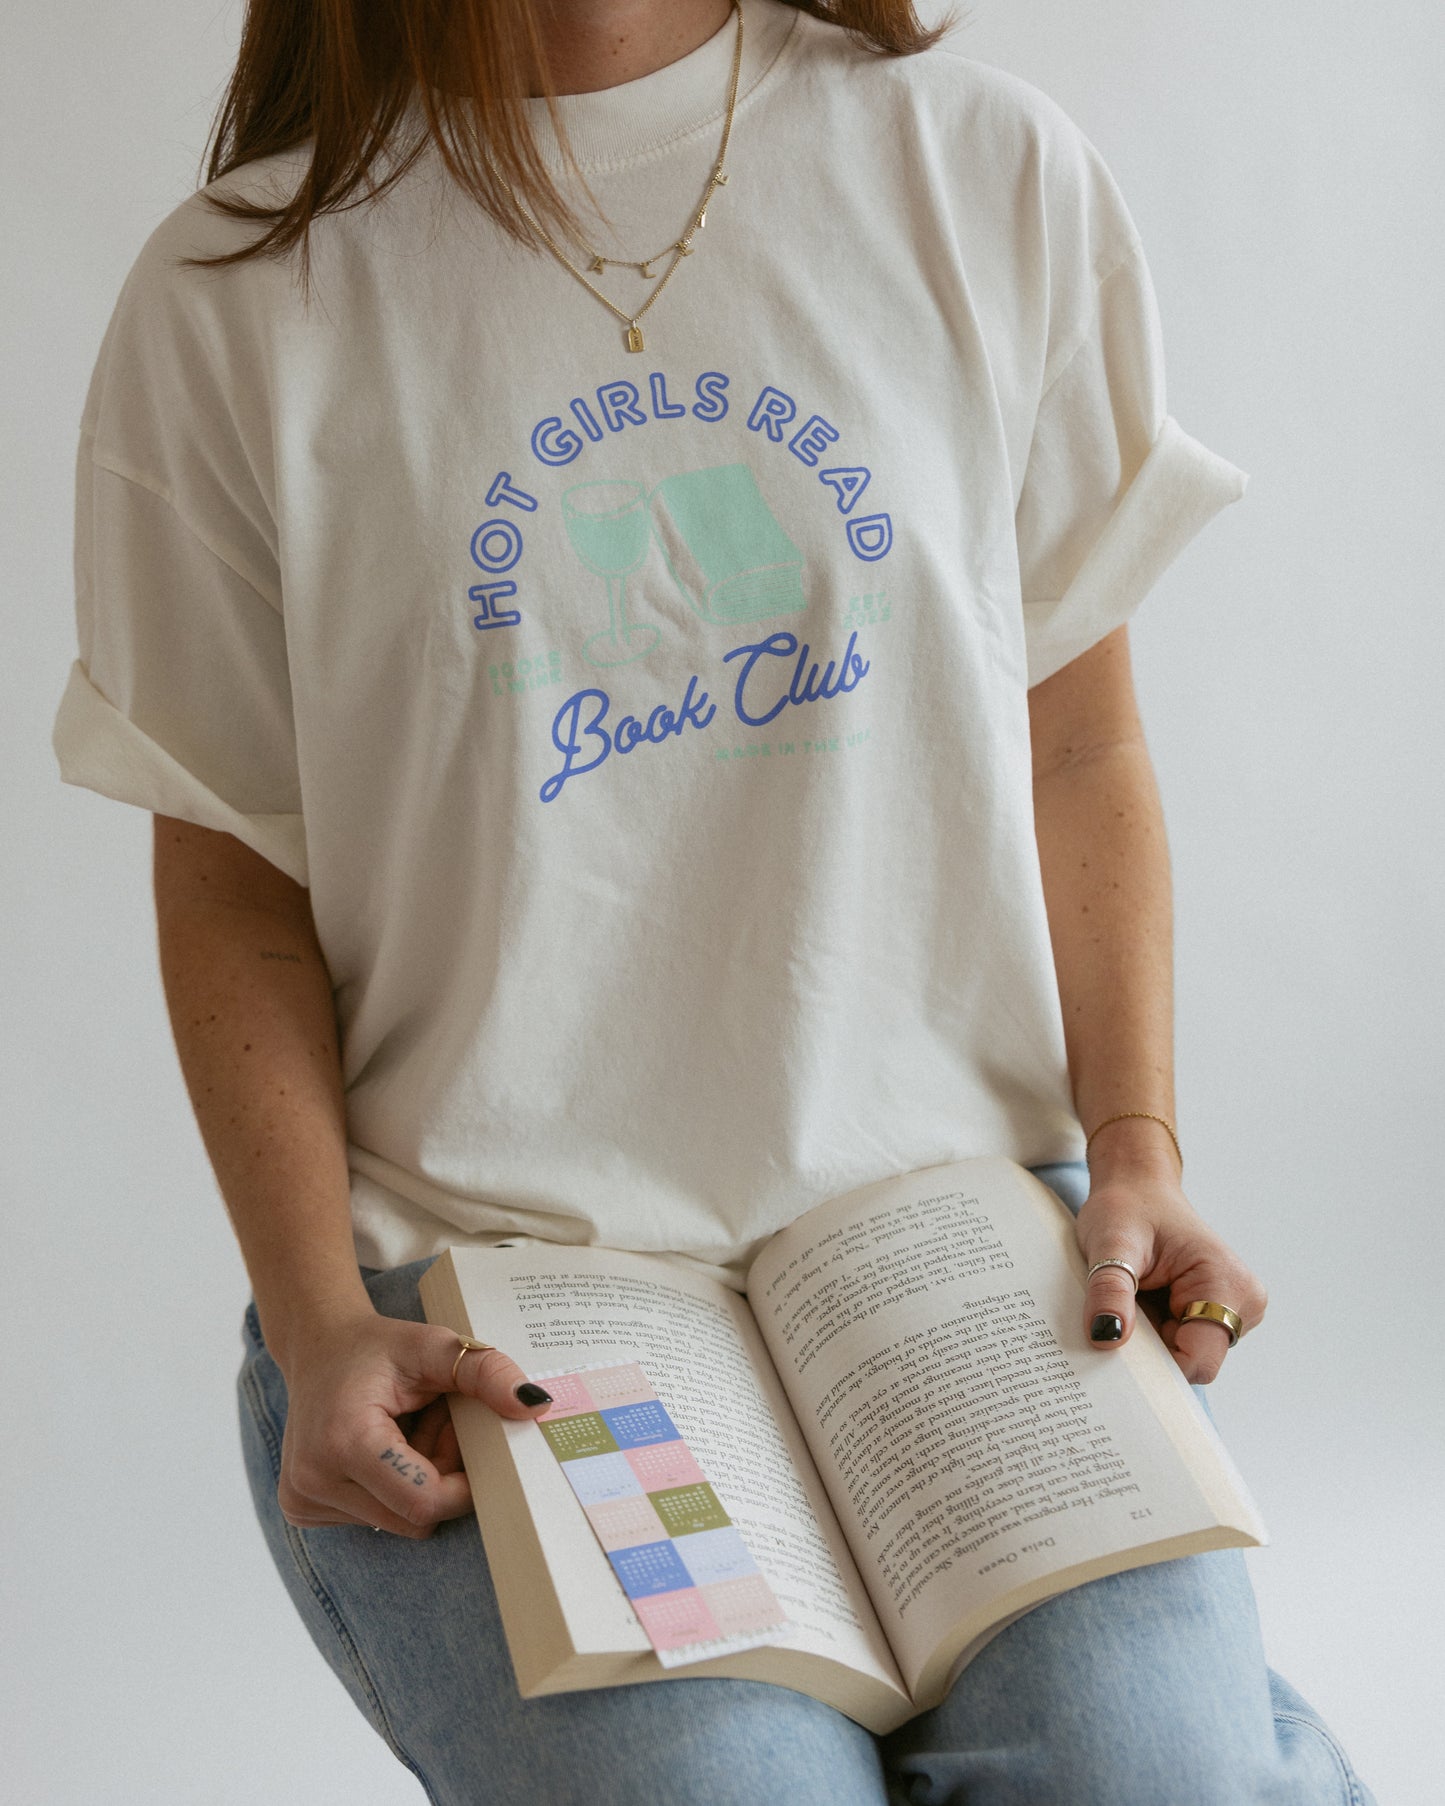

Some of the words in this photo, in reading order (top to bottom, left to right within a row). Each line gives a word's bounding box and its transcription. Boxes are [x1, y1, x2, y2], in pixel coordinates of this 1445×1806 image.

[468, 471, 538, 631] HOT
[530, 371, 730, 467] GIRLS
[747, 385, 893, 562] READ
[539, 675, 717, 804] Book
[722, 630, 870, 727] Club
[716, 743, 772, 761] MADE
[803, 738, 839, 753] THE
[539, 1274, 556, 1282] the
[560, 1273, 569, 1283] at
[573, 1273, 606, 1283] dinner
[958, 1266, 986, 1278] COLD
[509, 1275, 539, 1284] diner
[543, 1280, 590, 1292] pumpkin
[591, 1282, 611, 1290] and
[929, 1274, 955, 1286] DAY,
[516, 1292, 566, 1301] cranberry
[569, 1289, 614, 1300] dressing,
[904, 1283, 929, 1296] long
[545, 1301, 570, 1310] food
[574, 1300, 591, 1308] the
[595, 1301, 629, 1310] heated
[882, 1292, 904, 1307] after
[851, 1309, 868, 1322] the
[868, 1303, 881, 1315] all
[524, 1321, 547, 1330] into
[548, 1318, 586, 1328] change
[588, 1319, 605, 1327] she
[990, 1311, 1030, 1328] Within
[549, 1329, 576, 1338] from
[953, 1326, 972, 1336] the
[973, 1321, 988, 1333] all
[528, 1331, 546, 1342] the
[814, 1319, 851, 1352] sycamore
[917, 1333, 952, 1351] worlds
[530, 1338, 573, 1349] freezing
[575, 1339, 589, 1347] be
[618, 1339, 639, 1348] You
[1027, 1338, 1058, 1350] songs
[904, 1347, 916, 1360] of
[975, 1352, 1002, 1366] their
[1003, 1346, 1025, 1359] and
[1033, 1349, 1063, 1360] cause
[798, 1349, 816, 1375] leaves
[864, 1353, 904, 1378] biology,
[1013, 1356, 1032, 1366] the
[922, 1362, 973, 1387] meanings
[985, 1361, 1012, 1376] cool,
[953, 1370, 983, 1386] moist
[1041, 1370, 1075, 1382] others
[847, 1377, 863, 1392] she
[937, 1382, 952, 1393] air
[1000, 1378, 1039, 1398] remain
[1046, 1381, 1081, 1395] divide
[890, 1383, 920, 1404] much
[922, 1390, 937, 1403] of
[1022, 1389, 1044, 1403] and
[1053, 1391, 1087, 1404] adjust
[819, 1390, 847, 1429] searched
[926, 1390, 999, 1426] uncommitted
[968, 1395, 1020, 1419] specialize
[1017, 1404, 1038, 1415] the
[1039, 1400, 1052, 1408] to
[856, 1400, 890, 1430] farther.
[878, 1394, 922, 1430] morning
[913, 1421, 926, 1431] as
[943, 1415, 968, 1434] into
[947, 1411, 1015, 1441] ever-shifting
[1055, 1415, 1087, 1429] Alone
[843, 1427, 855, 1447] All
[888, 1428, 913, 1446] stem
[913, 1426, 943, 1446] lungs
[1037, 1425, 1054, 1435] for
[851, 1423, 879, 1452] carries
[1000, 1430, 1037, 1448] hours,
[833, 1442, 845, 1460] her
[900, 1443, 912, 1455] or
[914, 1438, 946, 1459] earth;
[986, 1442, 1001, 1453] by
[837, 1448, 853, 1471] their
[869, 1445, 888, 1465] cells
[965, 1449, 984, 1461] the
[1029, 1454, 1044, 1467] all
[859, 1462, 870, 1474] in
[869, 1452, 900, 1478] hearts,
[892, 1456, 915, 1475] how
[939, 1457, 966, 1474] light
[1006, 1460, 1029, 1472] like
[1069, 1465, 1092, 1479] you
[1092, 1459, 1125, 1472] thing
[847, 1473, 860, 1493] case
[870, 1473, 892, 1496] some
[927, 1471, 939, 1485] of
[964, 1465, 1004, 1490] giraffes
[1046, 1475, 1068, 1486] can
[852, 1480, 869, 1505] while
[909, 1478, 926, 1493] the
[1015, 1482, 1046, 1496] learn
[944, 1487, 963, 1502] not
[856, 1495, 870, 1517] cells
[878, 1490, 911, 1520] lantern,
[914, 1498, 943, 1521] using
[1130, 1507, 1152, 1520] 172
[866, 1521, 880, 1540] Kya
[895, 1519, 915, 1541] their
[941, 1524, 953, 1535] It
[921, 1533, 941, 1549] was
[1020, 1536, 1056, 1553] Delia
[876, 1538, 894, 1565] necks
[908, 1547, 921, 1561] up
[898, 1560, 908, 1572] to
[977, 1552, 1018, 1575] Owens
